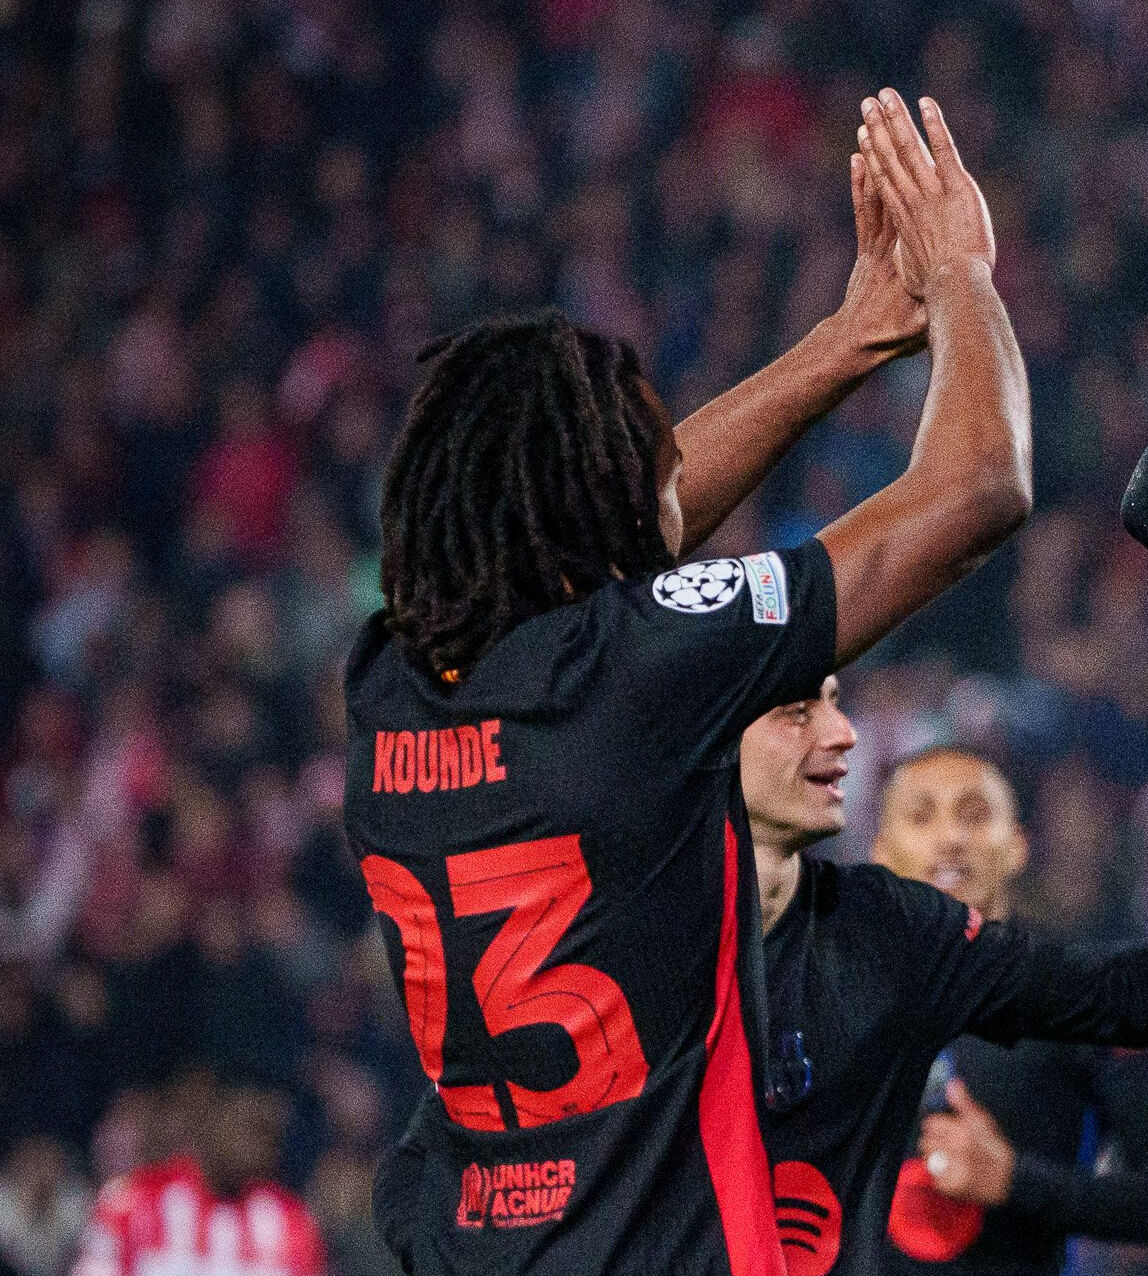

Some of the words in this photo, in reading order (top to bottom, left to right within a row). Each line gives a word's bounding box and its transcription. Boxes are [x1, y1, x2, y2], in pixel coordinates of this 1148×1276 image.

[681, 572, 715, 588] 5
[372, 718, 507, 794] KOUNDE
[360, 834, 650, 1132] 23
[493, 1159, 576, 1190] UNHCR
[491, 1186, 573, 1217] ACNUR
